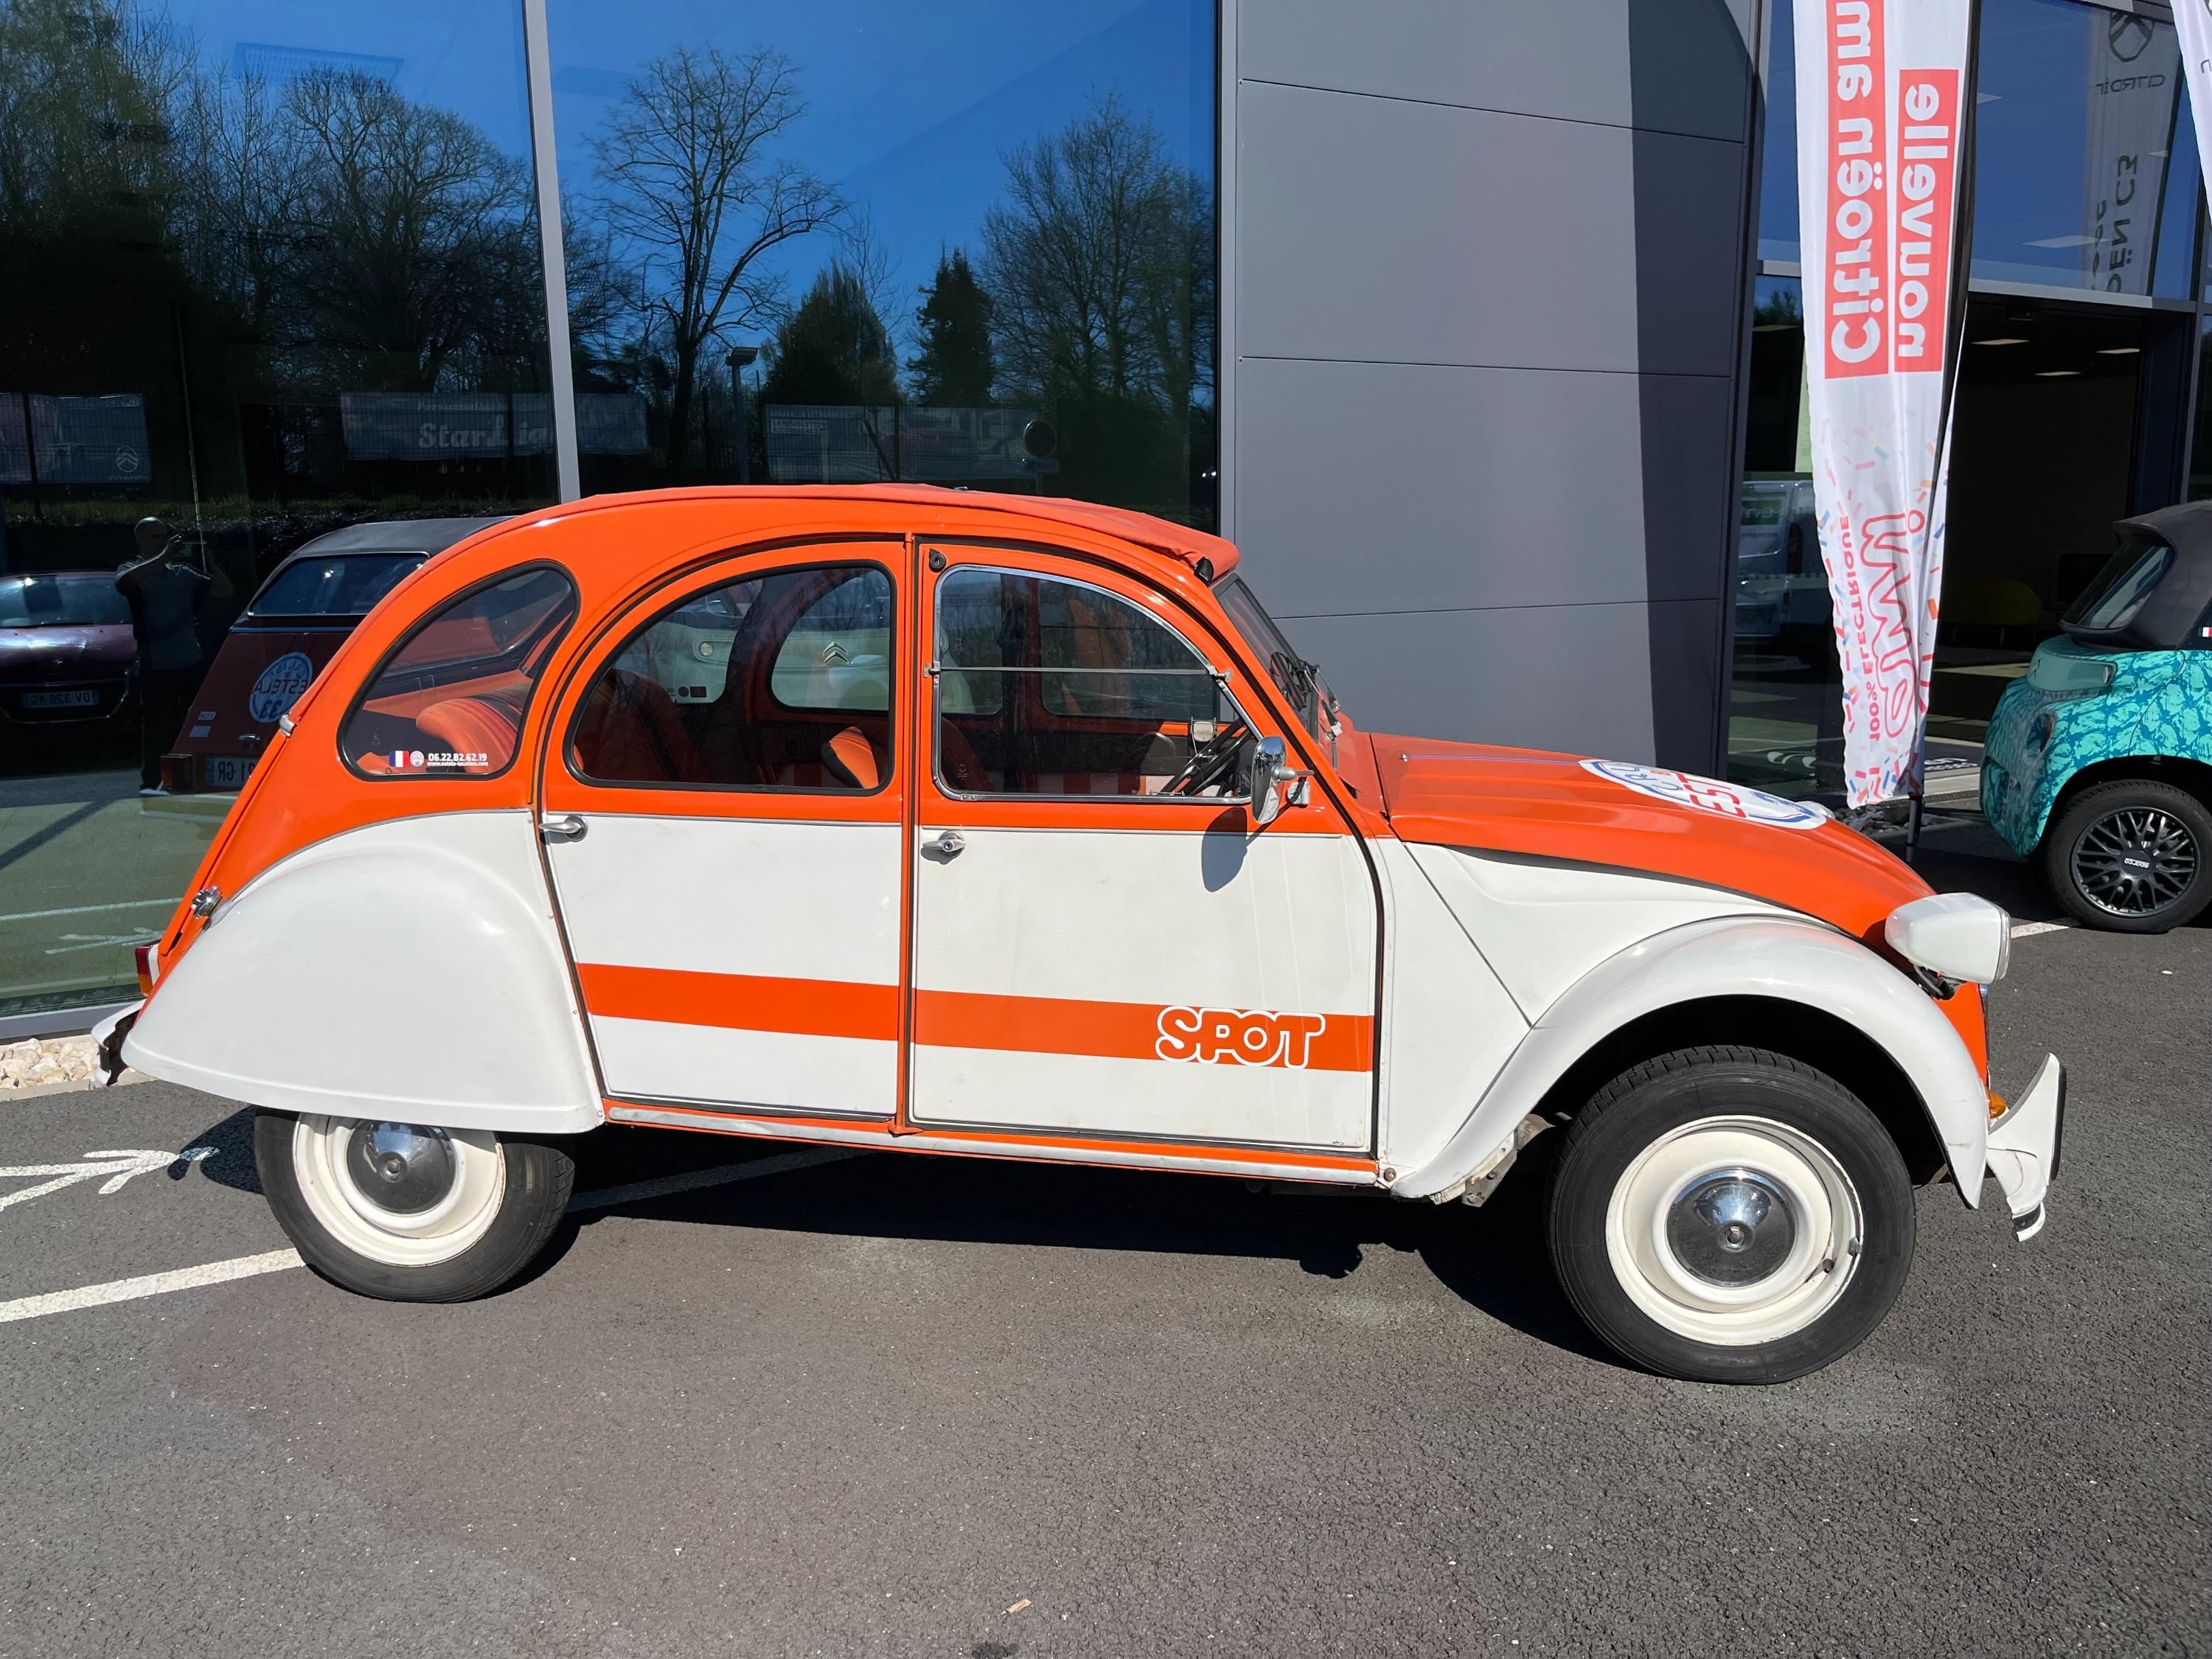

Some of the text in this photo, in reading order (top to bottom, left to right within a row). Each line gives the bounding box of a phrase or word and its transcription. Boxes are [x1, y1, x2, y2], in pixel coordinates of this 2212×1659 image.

[428, 753, 487, 762] 06.22.82.62.19
[1155, 1005, 1326, 1069] SPOT
[1615, 1102, 1692, 1154] MICHELIN
